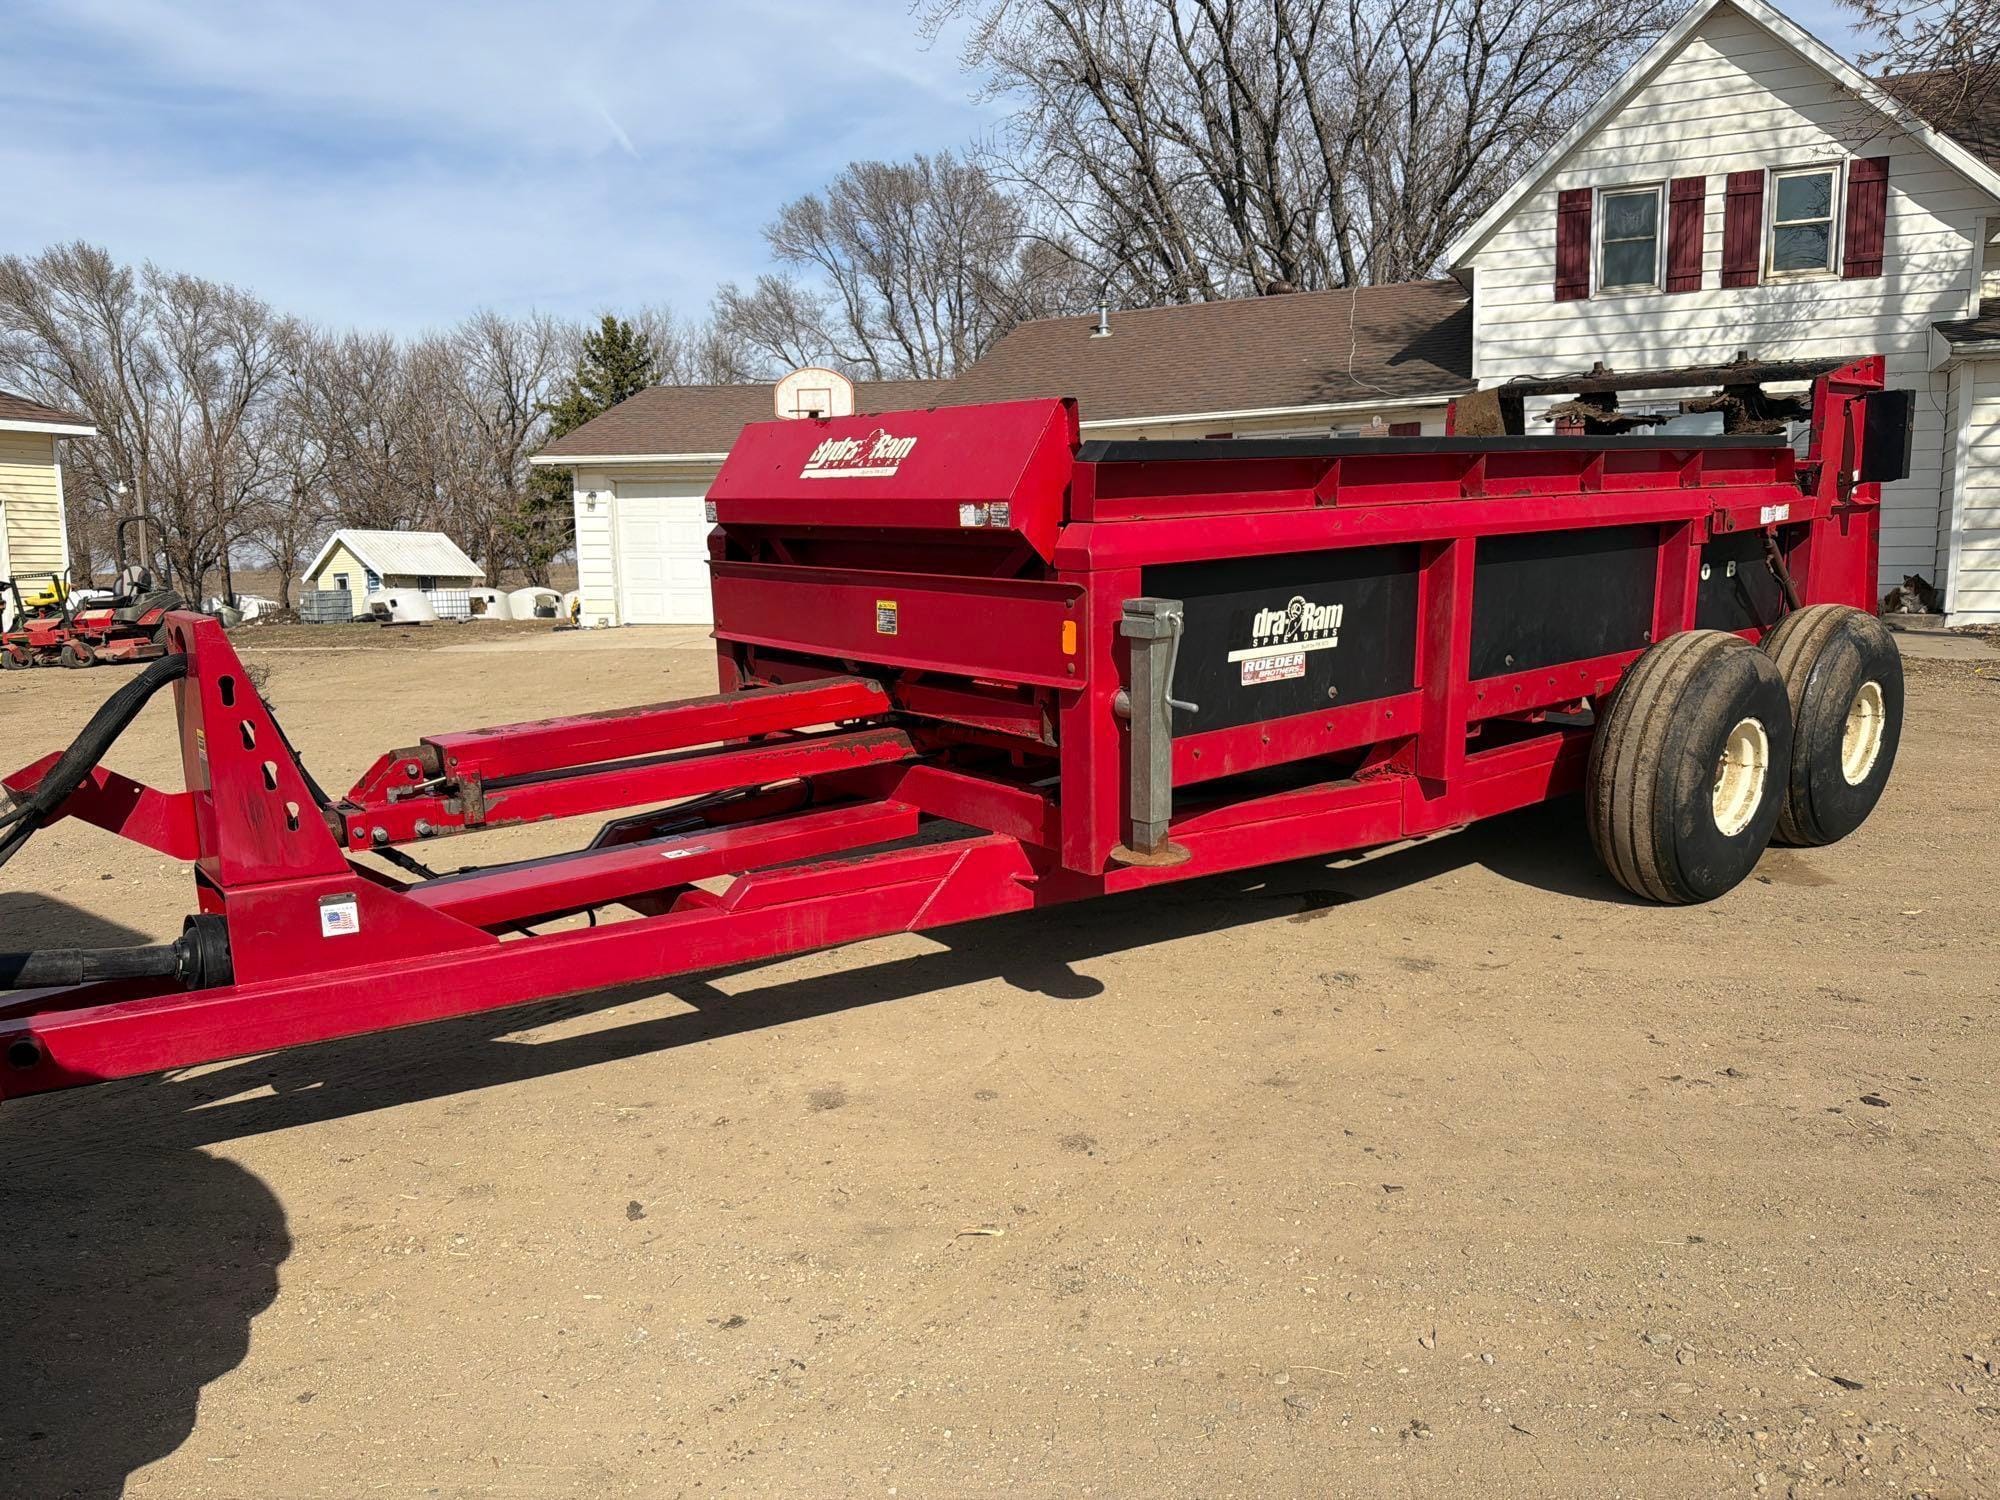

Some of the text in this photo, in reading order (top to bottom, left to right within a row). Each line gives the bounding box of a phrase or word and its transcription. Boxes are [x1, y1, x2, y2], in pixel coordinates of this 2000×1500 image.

[869, 434, 917, 459] Ram
[1300, 602, 1343, 632] Ram
[1252, 628, 1338, 647] SPREADERS
[1244, 654, 1303, 673] ROEDER
